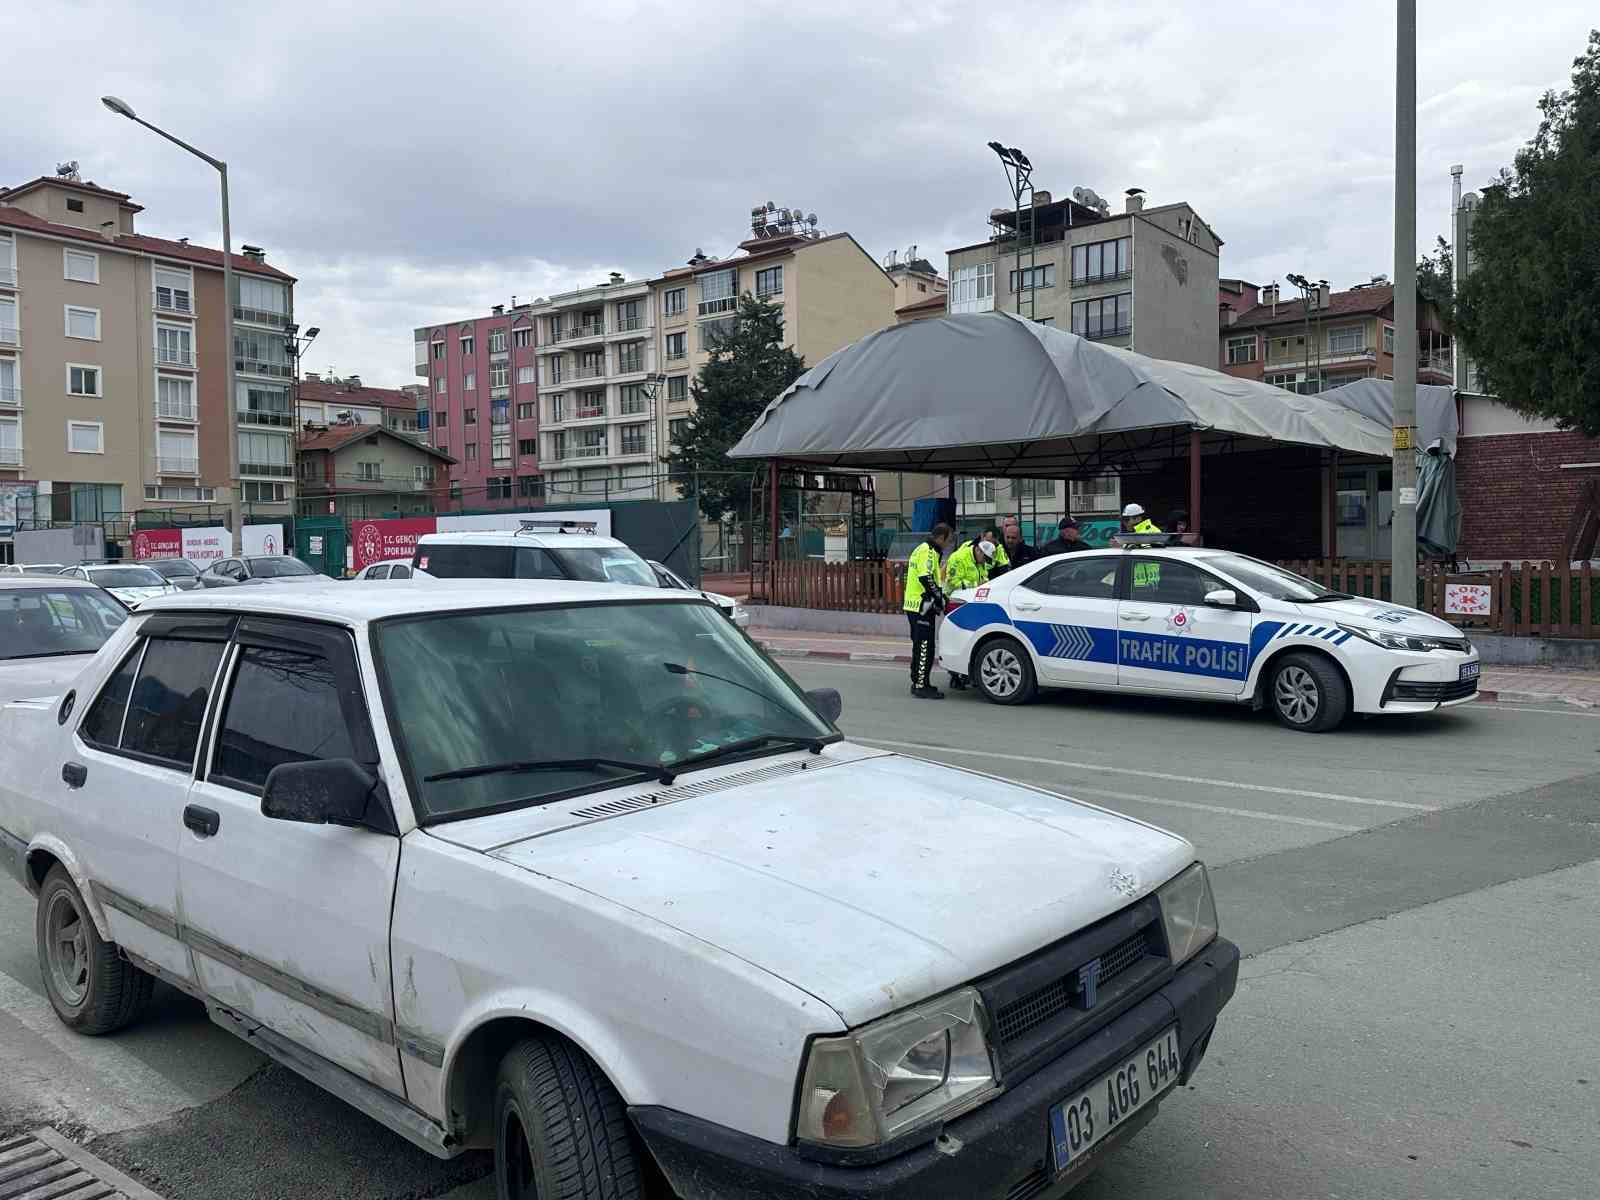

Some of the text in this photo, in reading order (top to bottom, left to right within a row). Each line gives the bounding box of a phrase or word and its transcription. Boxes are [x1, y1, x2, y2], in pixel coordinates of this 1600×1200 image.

[1121, 638, 1243, 673] TRAFİK POLİSİ
[1067, 1034, 1179, 1150] 03 AGG 644
